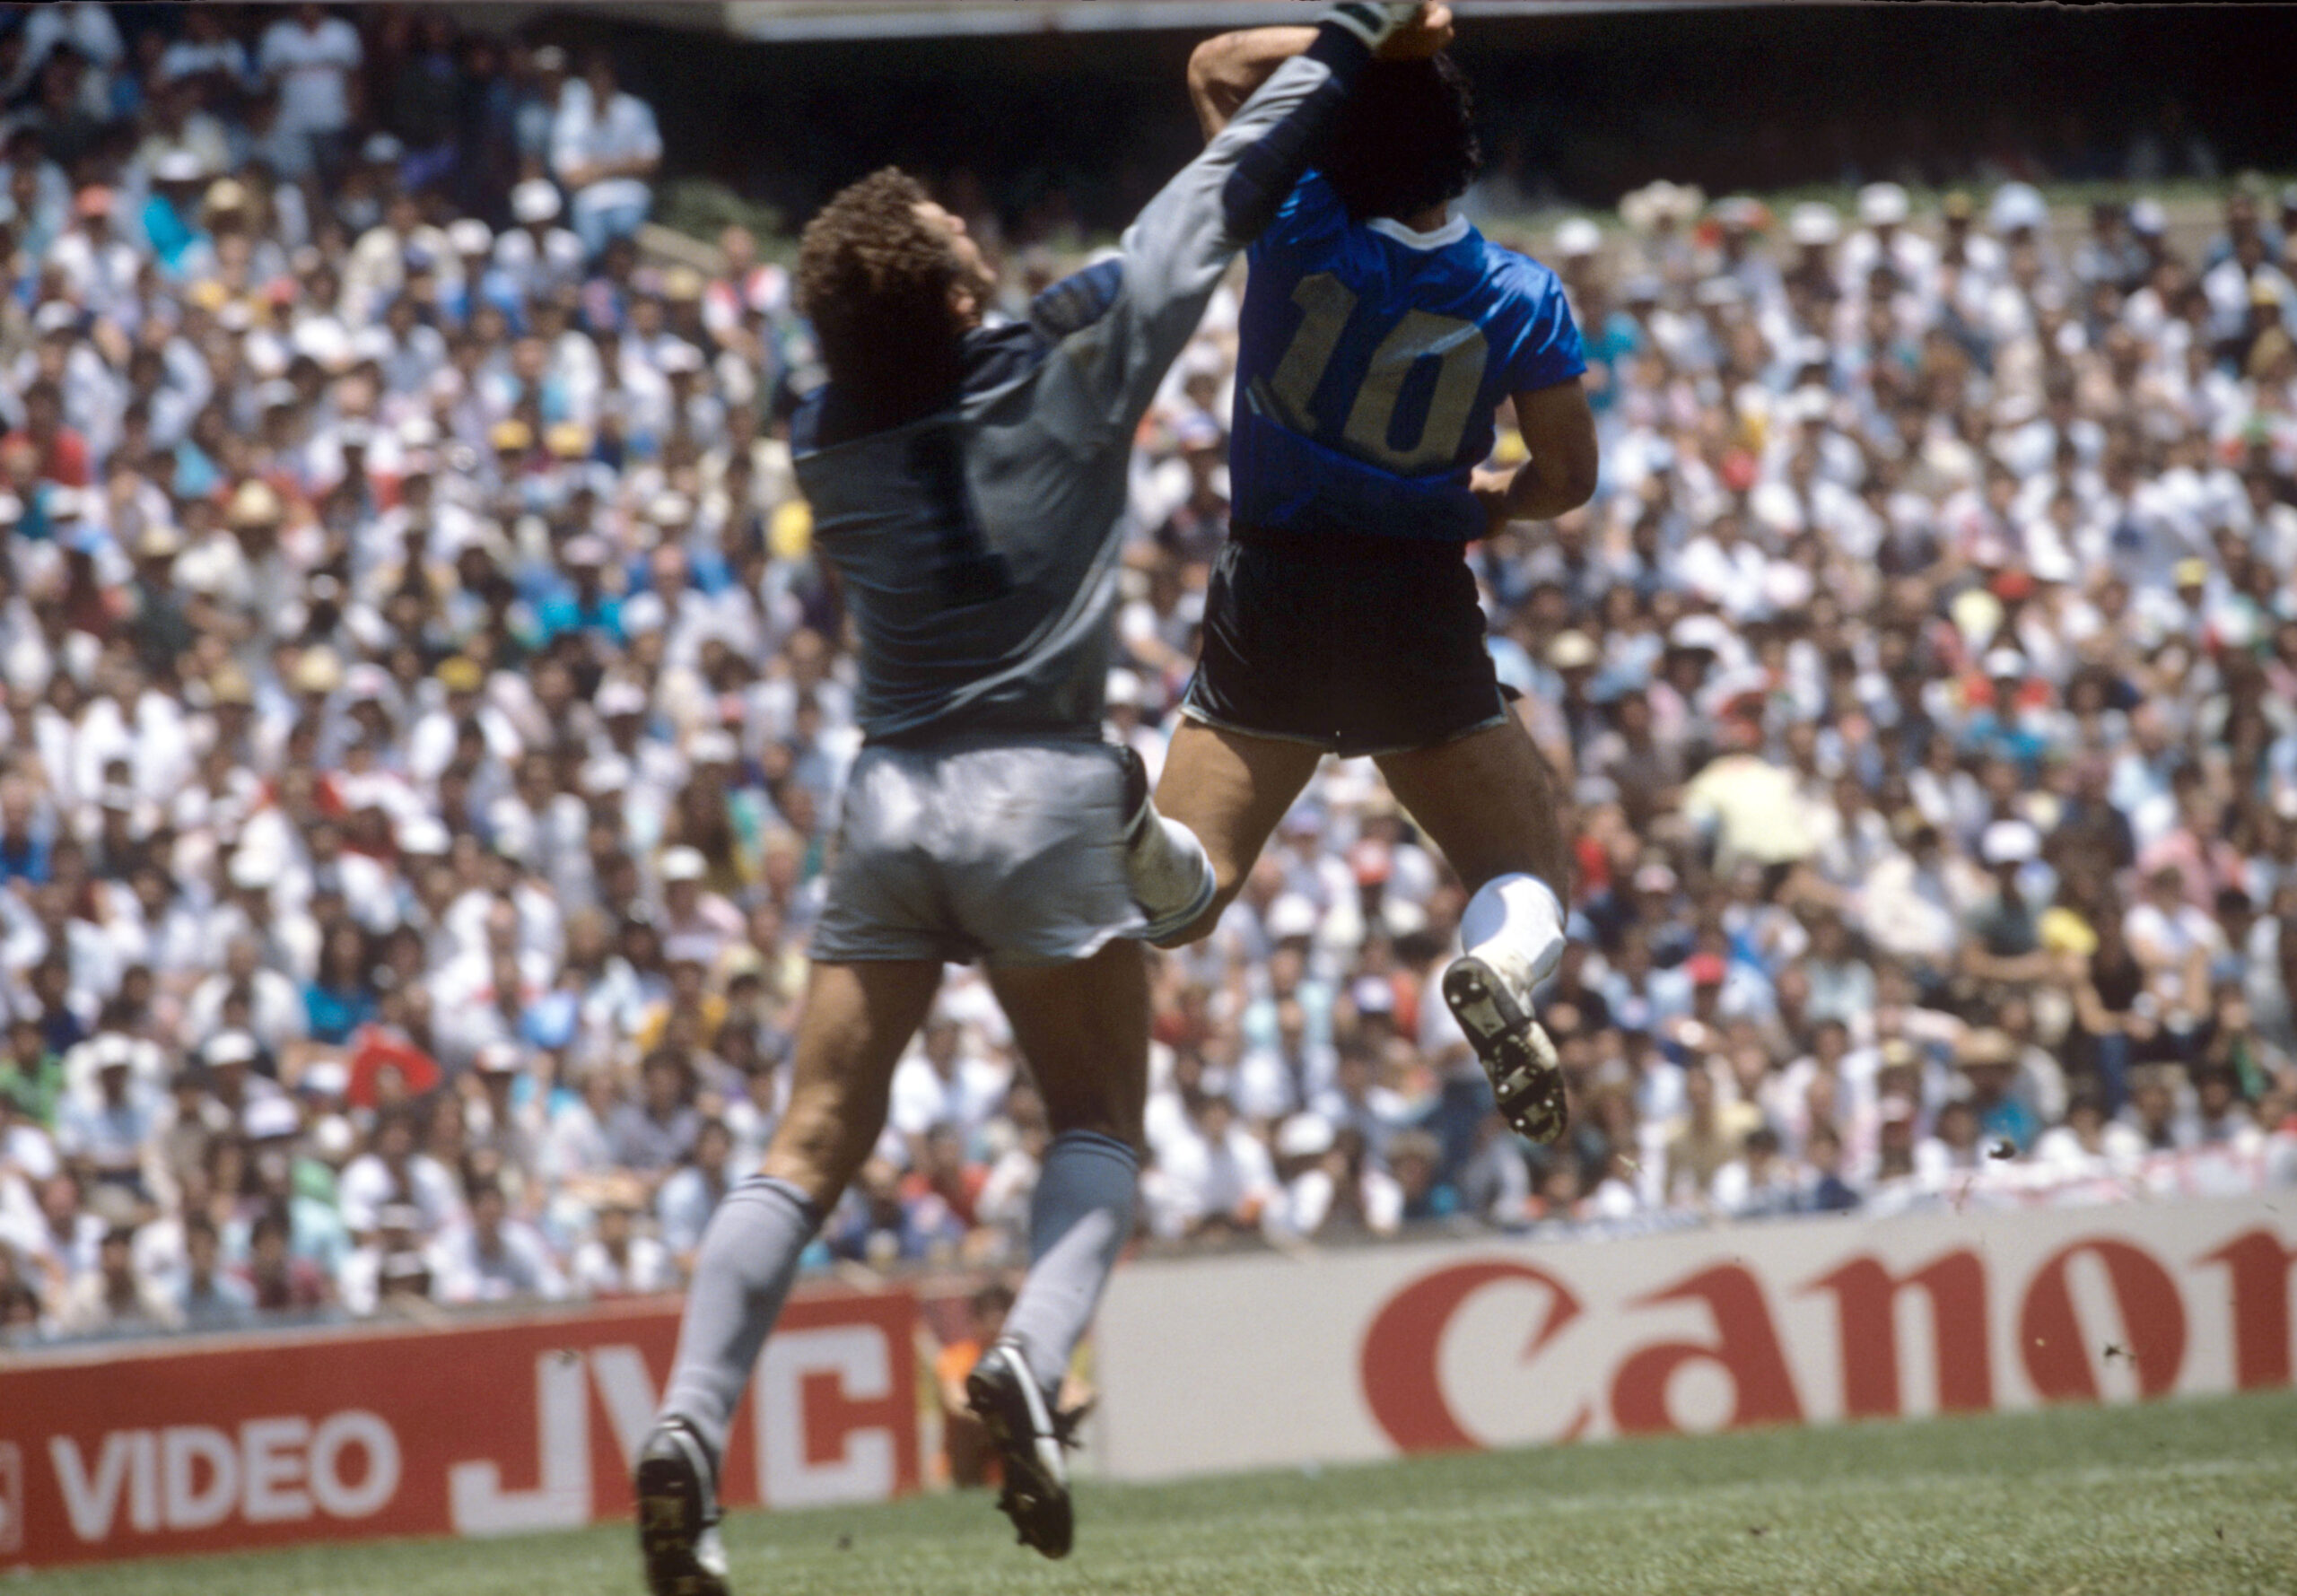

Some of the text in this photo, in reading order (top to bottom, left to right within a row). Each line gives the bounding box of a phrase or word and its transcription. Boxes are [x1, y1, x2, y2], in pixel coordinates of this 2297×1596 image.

[1245, 271, 1489, 467] 10
[903, 426, 1011, 609] 1
[48, 1409, 402, 1542] VIDEO
